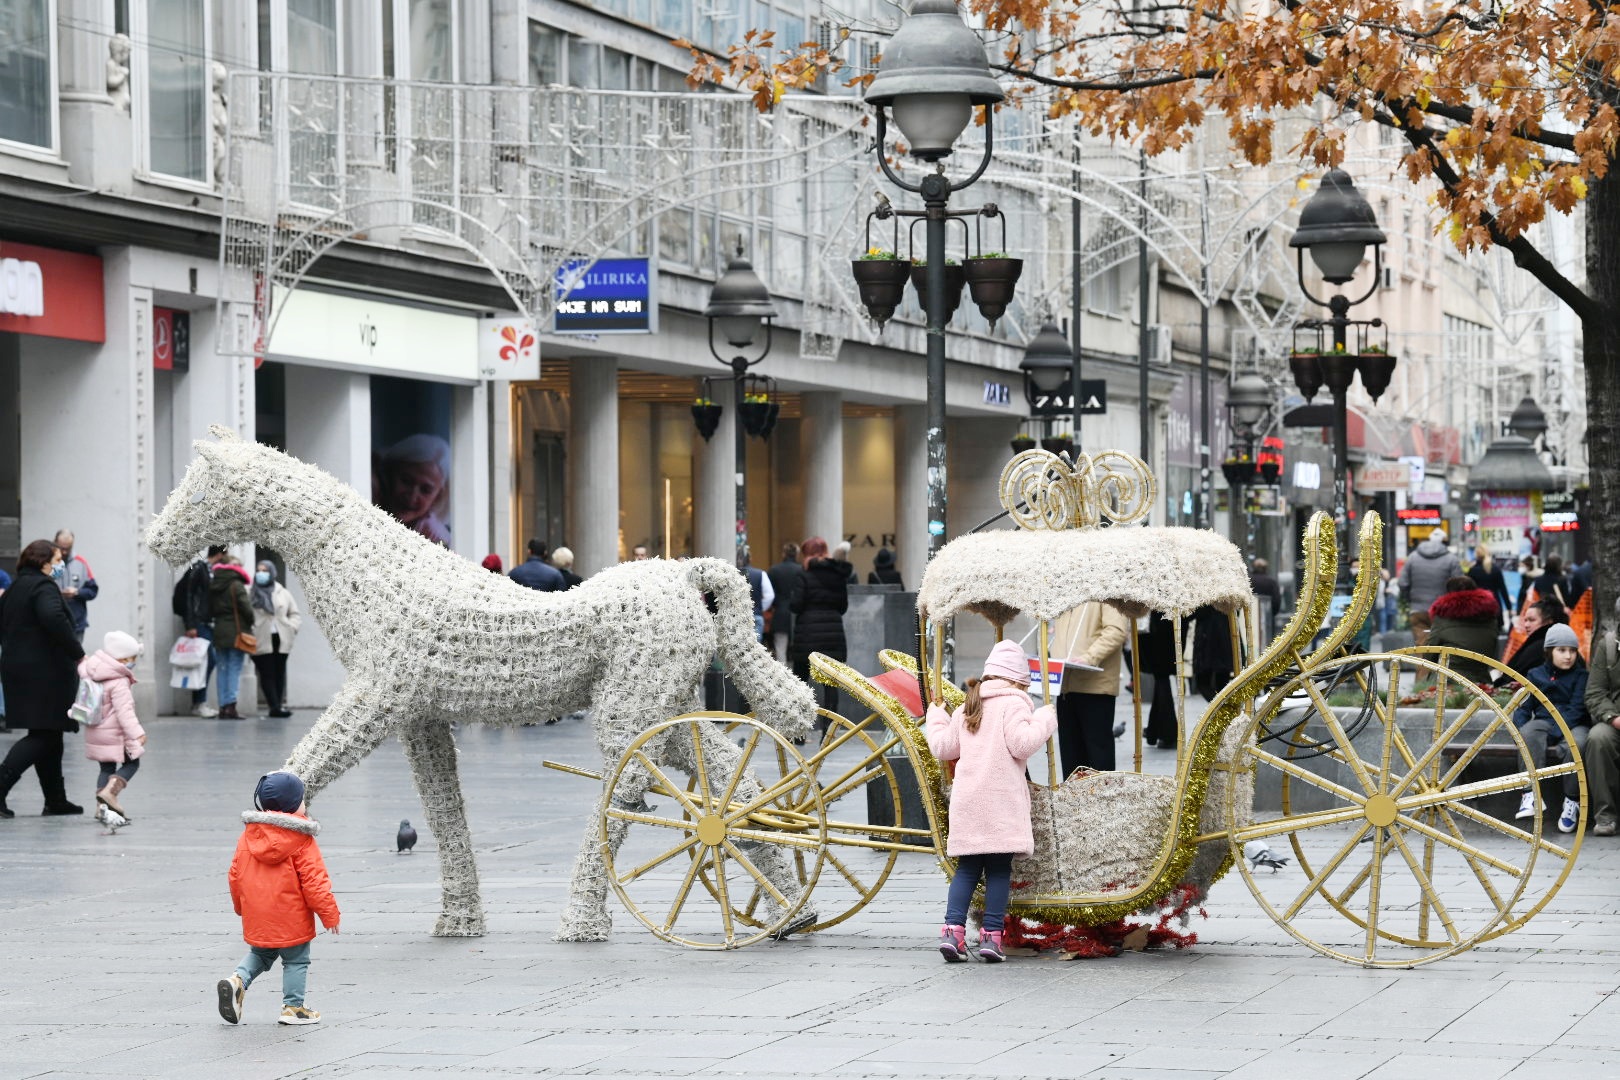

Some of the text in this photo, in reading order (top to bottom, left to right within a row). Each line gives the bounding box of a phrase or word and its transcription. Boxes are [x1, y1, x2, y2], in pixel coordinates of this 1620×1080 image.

[0, 257, 44, 317] on
[587, 272, 647, 286] ILIRIKA
[359, 313, 378, 356] vip
[481, 366, 496, 376] vip
